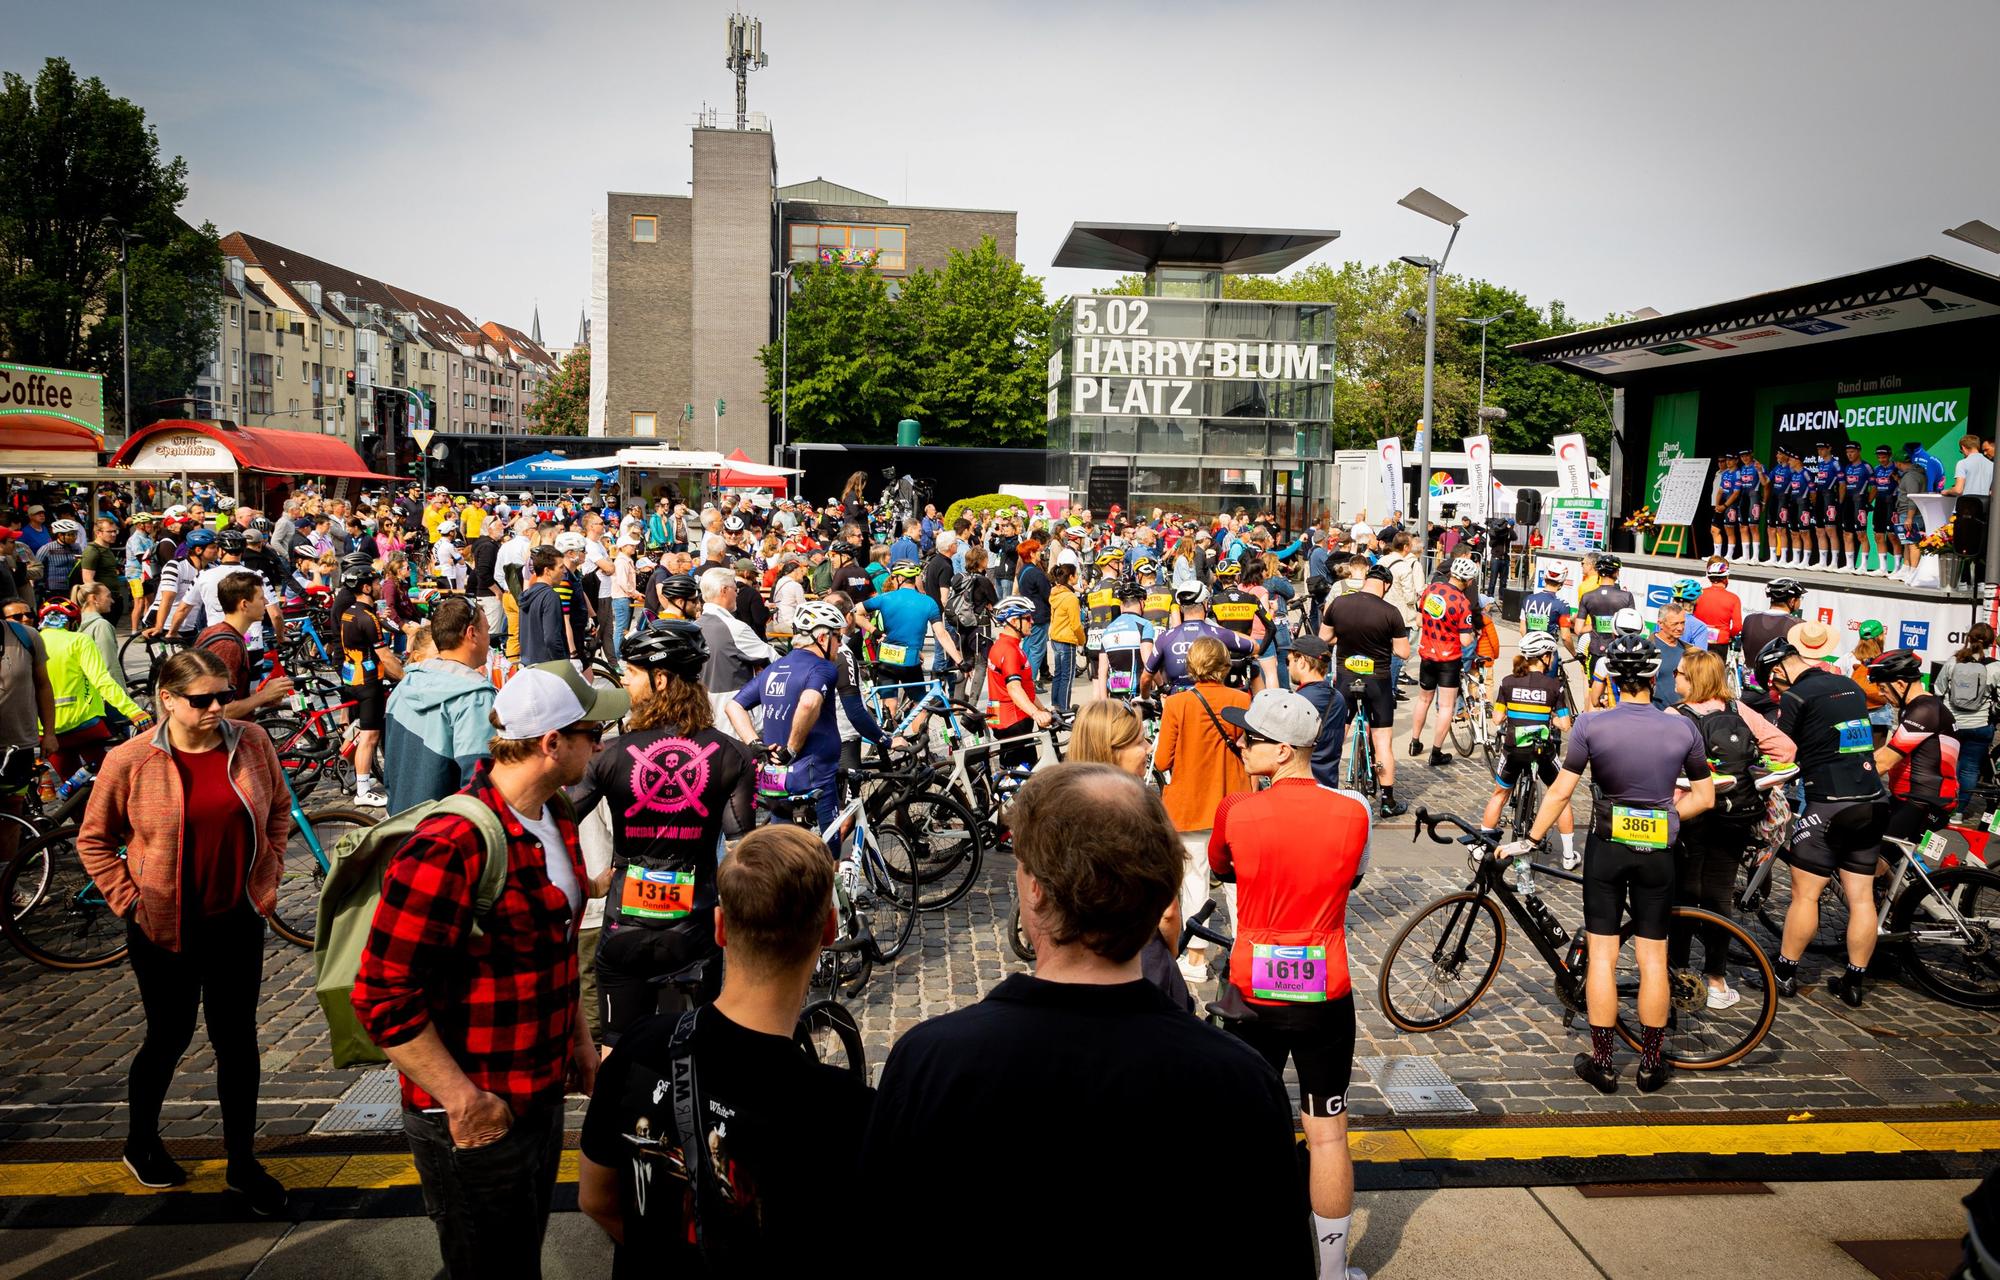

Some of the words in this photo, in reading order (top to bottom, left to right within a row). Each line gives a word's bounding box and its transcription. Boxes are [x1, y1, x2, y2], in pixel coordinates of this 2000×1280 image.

[1076, 299, 1149, 335] 5.02
[1075, 338, 1332, 380] HARRY-BLUM-
[0, 370, 73, 409] Coffee
[1837, 380, 1861, 394] Rund
[1863, 382, 1878, 391] um
[1880, 375, 1902, 389] Köln
[1075, 378, 1193, 415] PLATZ
[1779, 401, 1958, 432] ALPECIN-DECEUNINCK
[1902, 623, 1927, 635] Krombacher
[1350, 659, 1369, 667] 3015
[769, 681, 786, 695] SVA
[1622, 817, 1657, 833] 3861
[636, 881, 680, 902] 1315
[1265, 960, 1315, 980] 1619
[1275, 981, 1304, 990] Marcel
